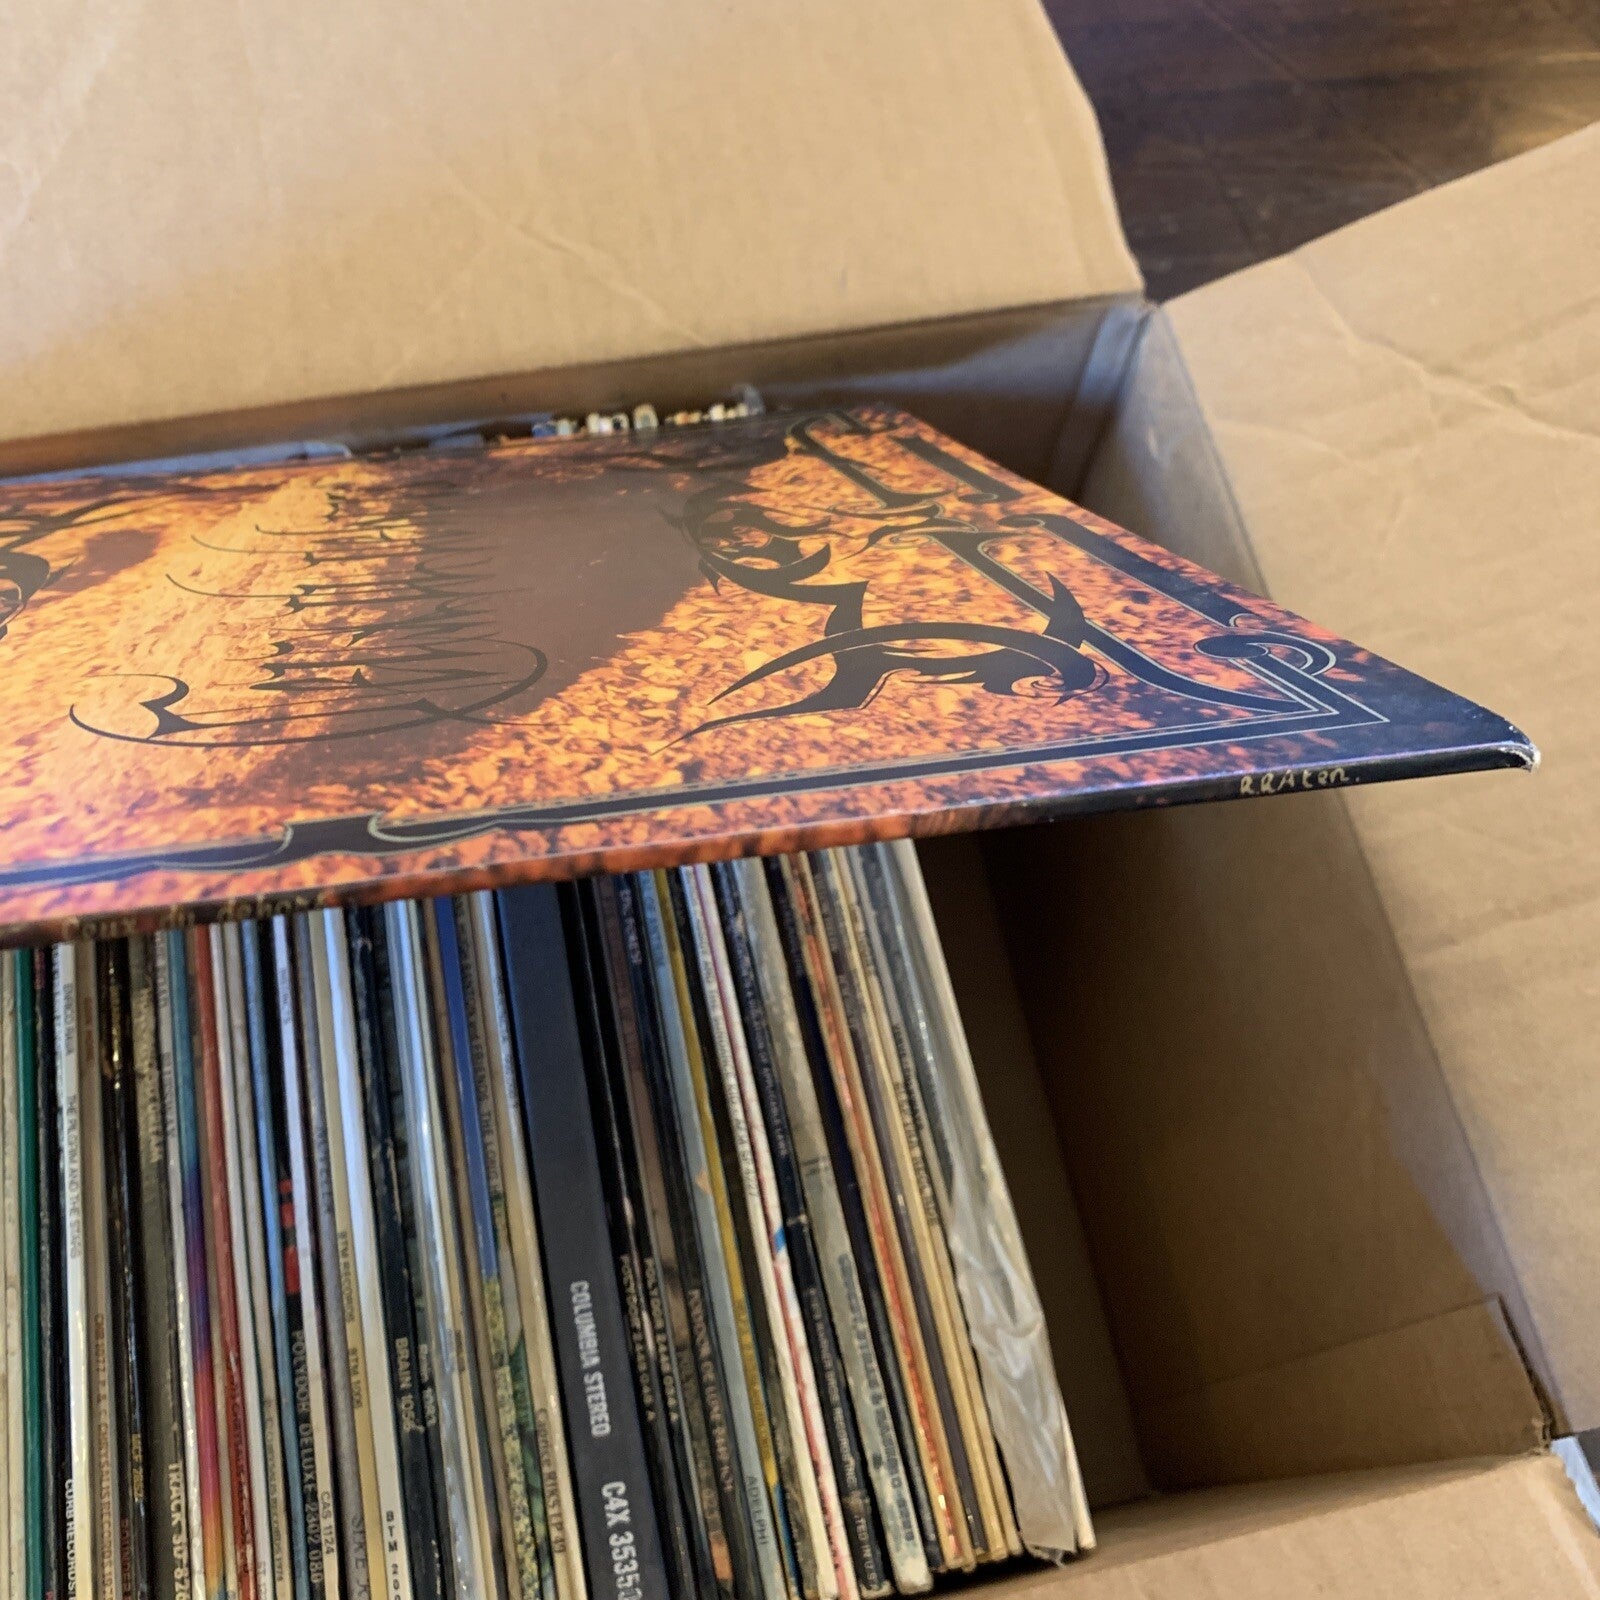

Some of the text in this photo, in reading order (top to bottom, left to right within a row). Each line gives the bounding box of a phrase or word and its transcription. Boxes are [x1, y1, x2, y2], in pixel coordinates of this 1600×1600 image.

[392, 1336, 413, 1389] BRAIN
[568, 1279, 614, 1438] COLUMBIA STEREO
[64, 1478, 75, 1520] CURB
[167, 1459, 184, 1524] TRACK
[601, 1481, 631, 1527] C4X
[746, 1475, 769, 1545] ADELPHI
[321, 1523, 335, 1555] 1124
